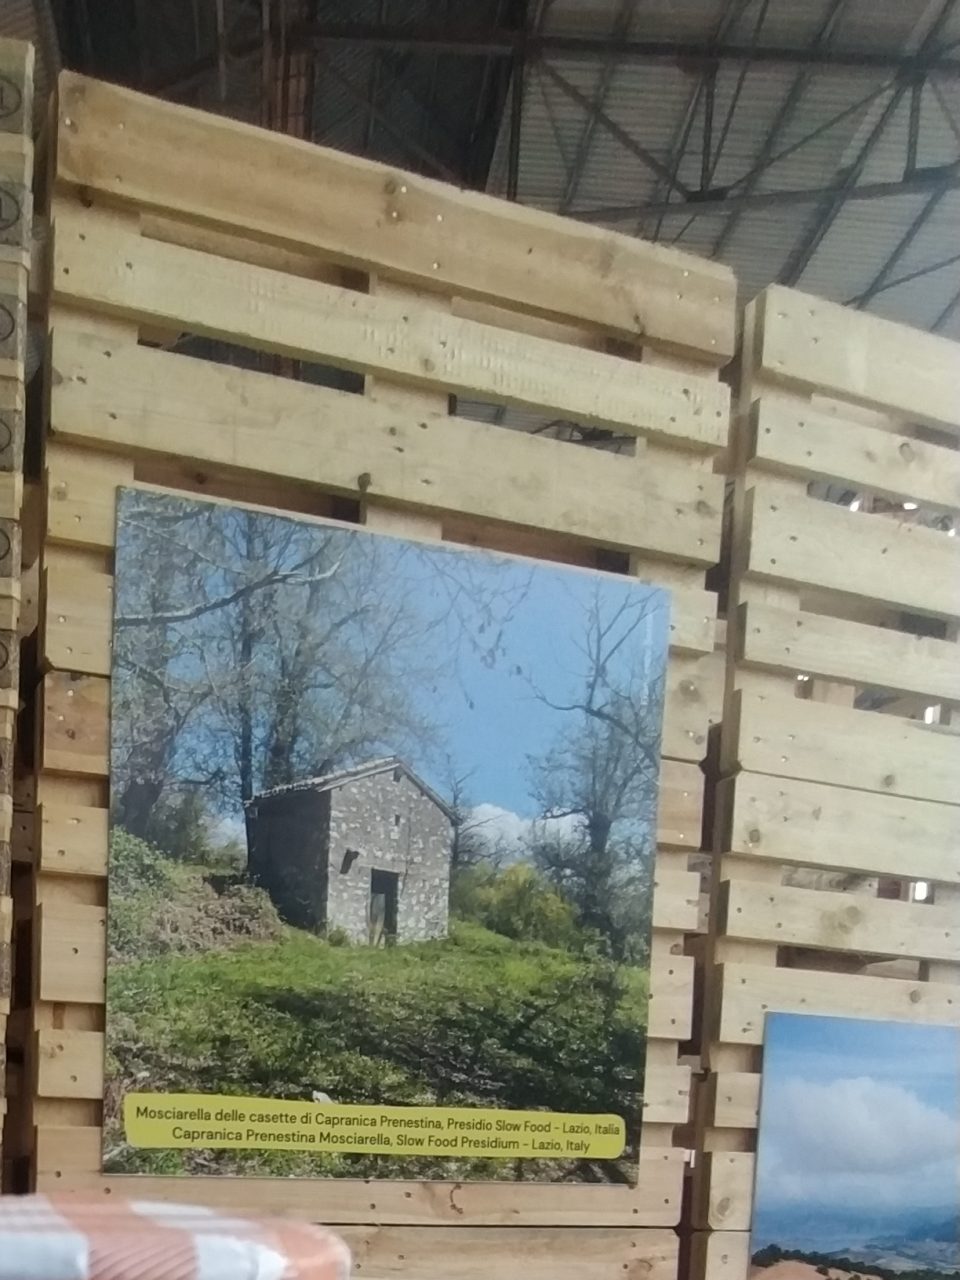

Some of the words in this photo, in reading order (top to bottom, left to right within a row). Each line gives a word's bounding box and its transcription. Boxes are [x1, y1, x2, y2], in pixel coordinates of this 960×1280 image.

[136, 1106, 211, 1121] Mosciarella
[215, 1108, 245, 1122] delle
[249, 1111, 297, 1124] casette
[300, 1111, 312, 1124] di
[315, 1112, 377, 1128] Capranica
[380, 1115, 444, 1131] Prenestina,
[447, 1117, 492, 1131] Presidio
[495, 1119, 521, 1132] Slow
[524, 1120, 551, 1133] Food
[563, 1122, 592, 1136] Lazio,
[594, 1123, 620, 1135] Italia
[172, 1126, 242, 1142] Capranica
[246, 1129, 315, 1143] Prenestina
[319, 1131, 393, 1147] Mosciarella,
[397, 1134, 424, 1146] Slow
[428, 1135, 457, 1148] Food
[461, 1136, 519, 1149] Presidium
[532, 1138, 563, 1152] Lazio,
[566, 1140, 590, 1154] Italy
